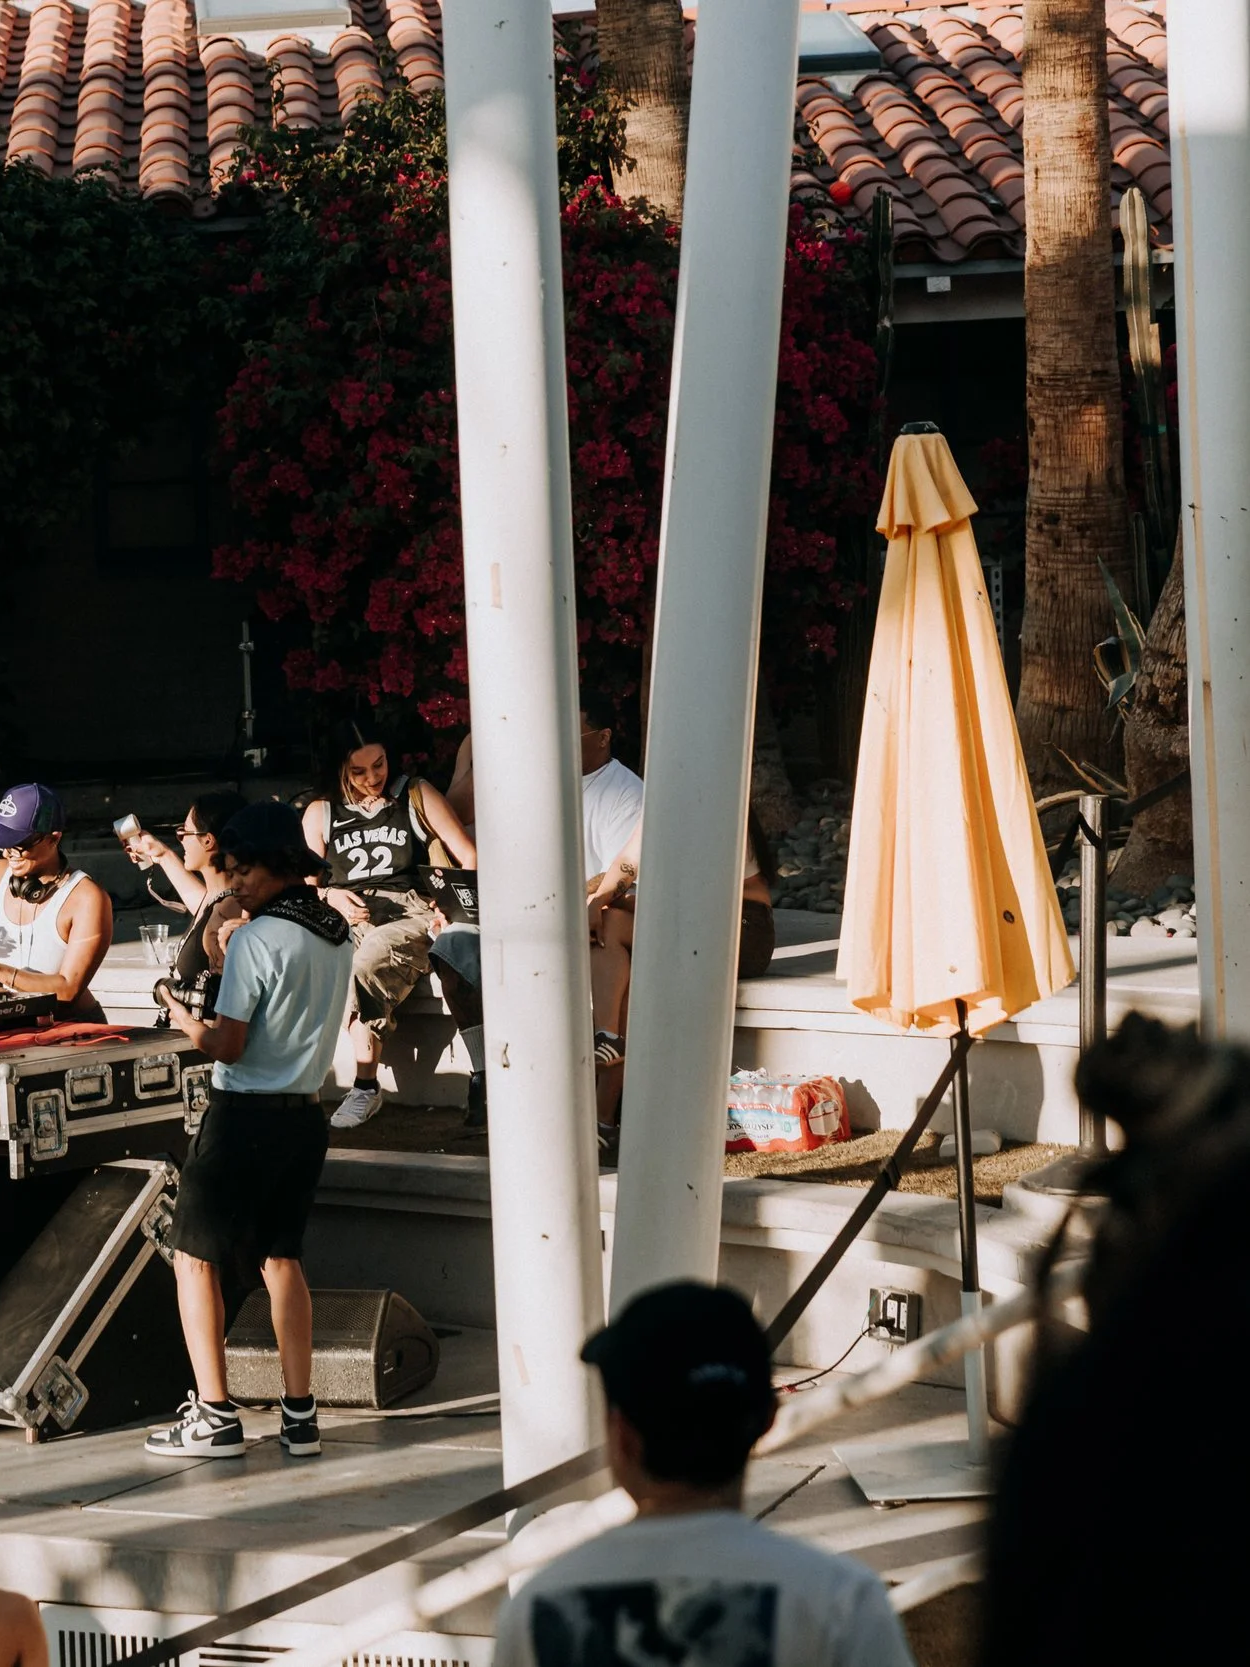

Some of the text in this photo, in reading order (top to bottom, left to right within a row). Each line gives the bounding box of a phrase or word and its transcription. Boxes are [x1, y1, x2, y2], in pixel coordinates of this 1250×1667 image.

[334, 825, 408, 854] LAS VEGAS
[347, 845, 394, 881] 22
